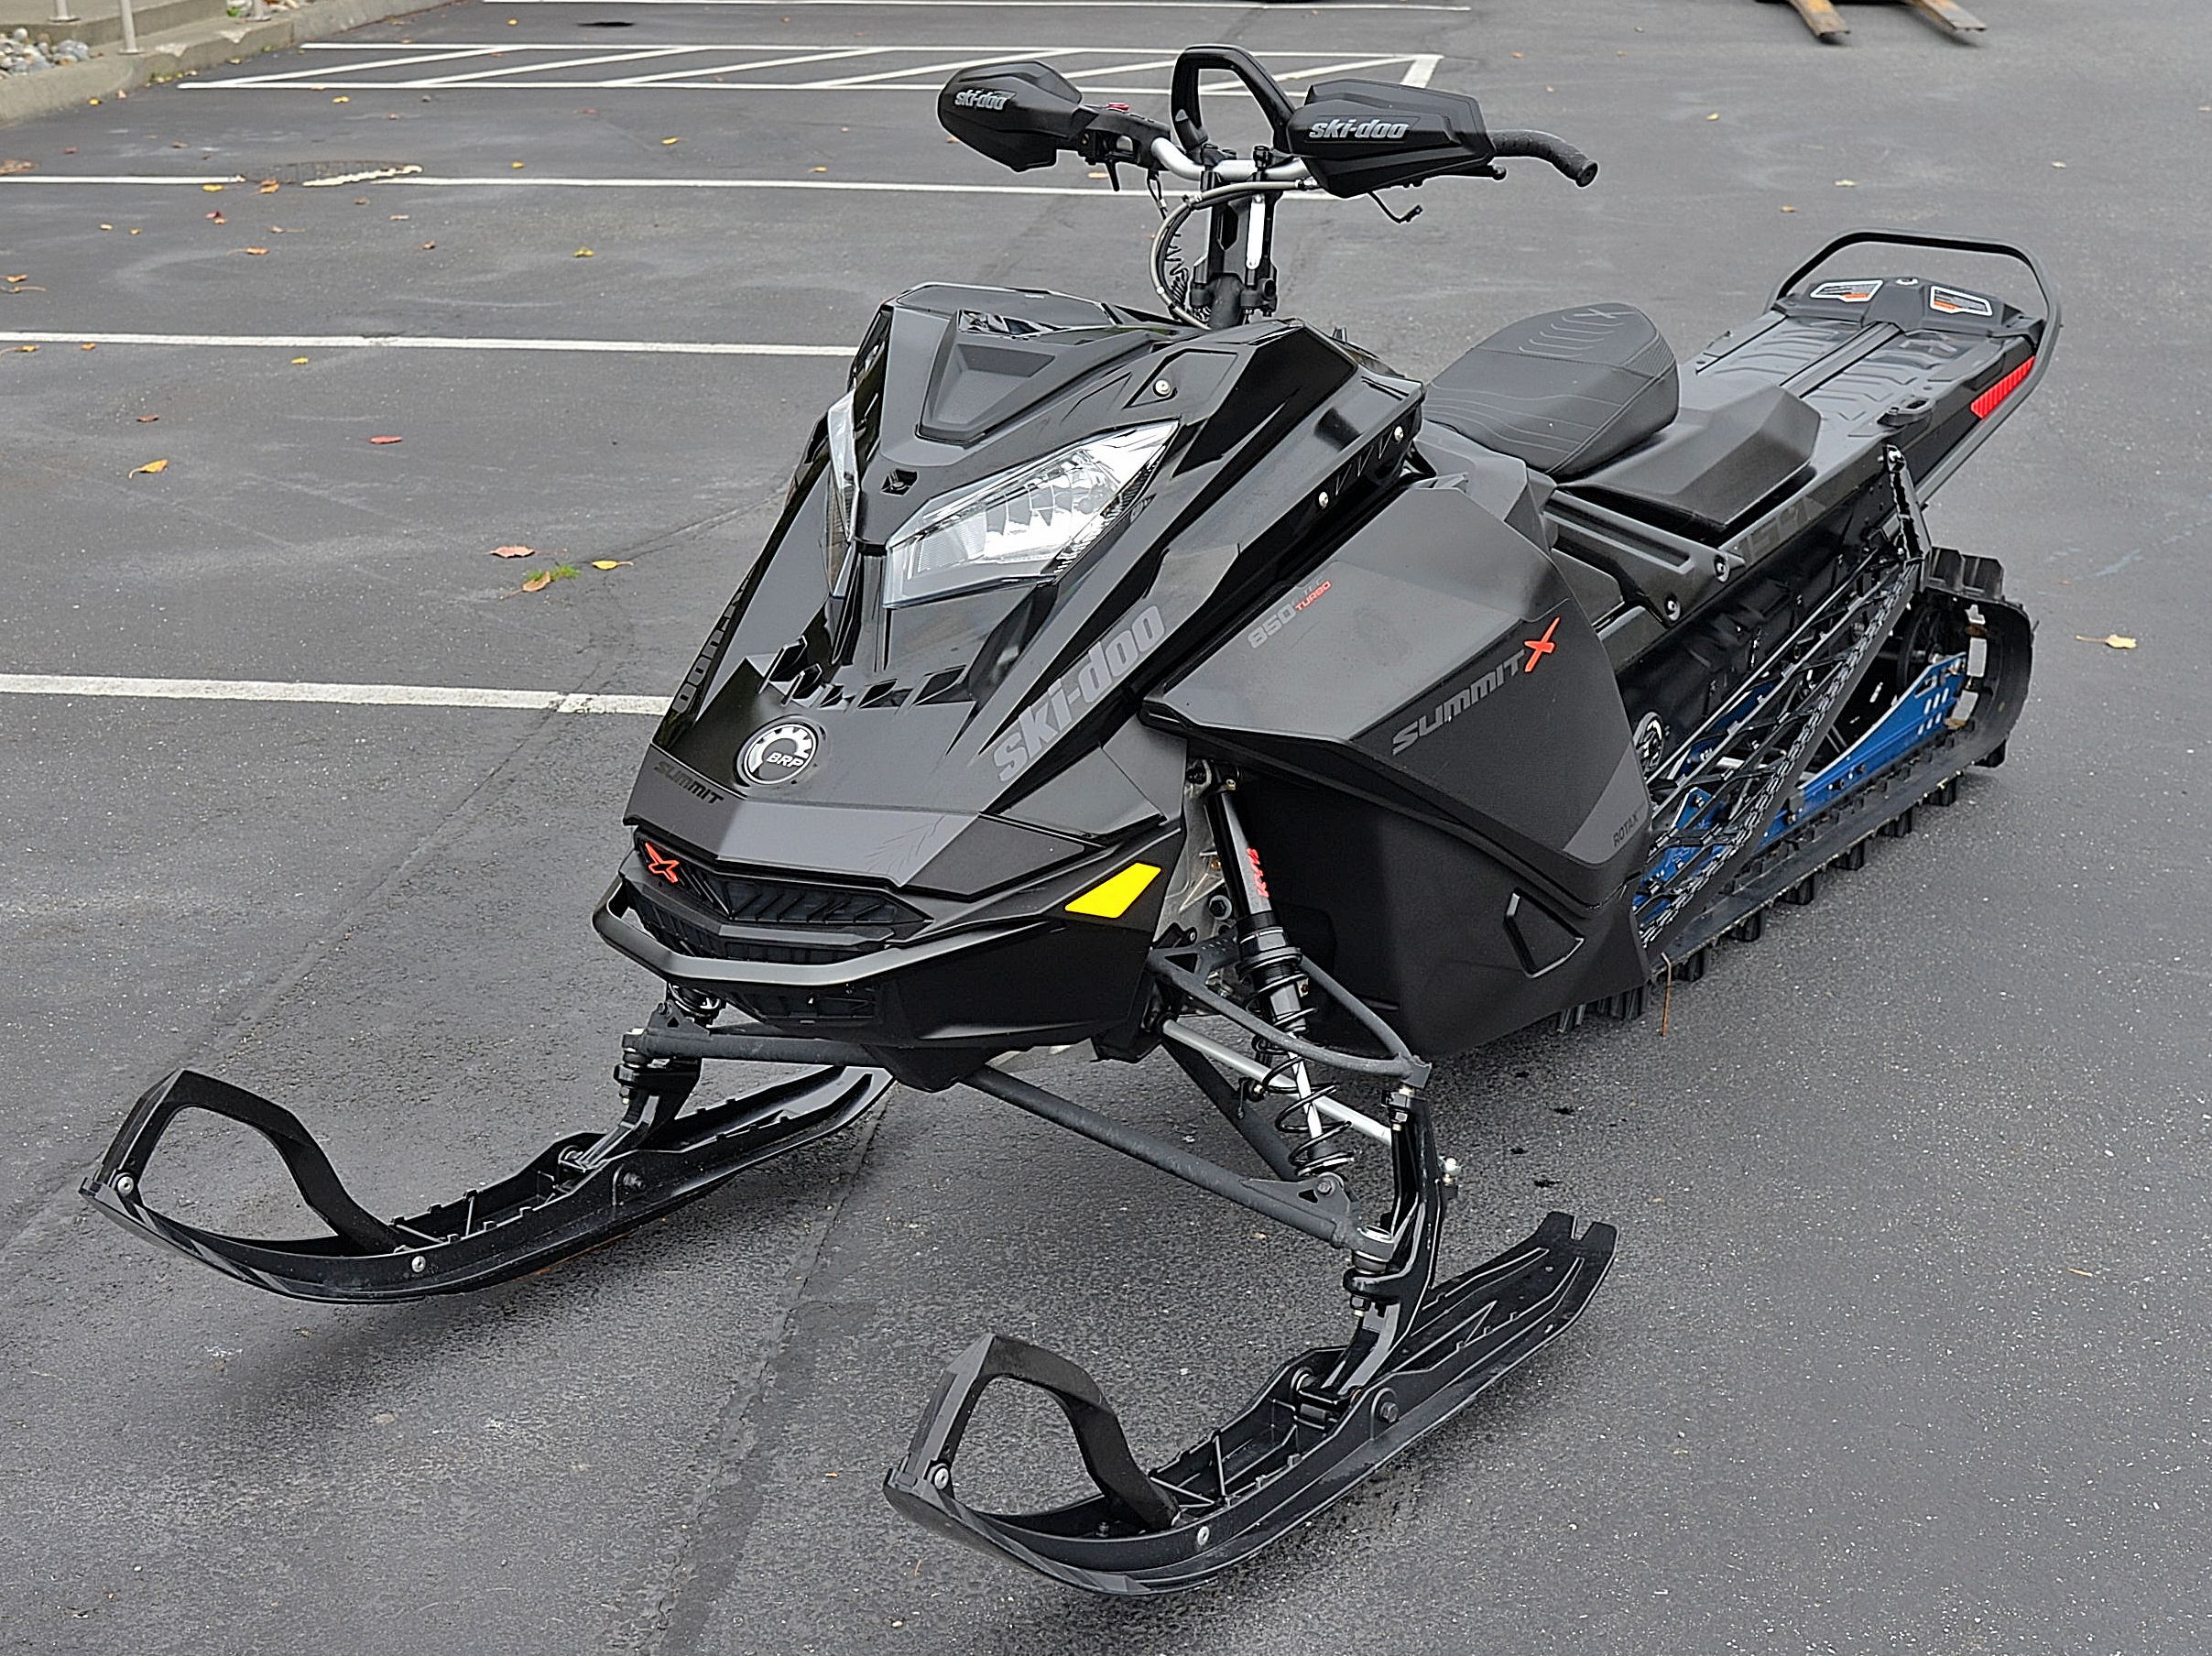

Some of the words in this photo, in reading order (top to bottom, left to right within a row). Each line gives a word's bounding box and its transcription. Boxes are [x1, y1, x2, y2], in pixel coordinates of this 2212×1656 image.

[954, 89, 1008, 110] ski-doo
[1309, 119, 1409, 138] ski-doo
[1295, 581, 1332, 611] TURBO
[1248, 604, 1297, 648] 850
[994, 605, 1166, 782] ski-doo
[1392, 648, 1525, 756] SUMMIT
[1523, 616, 1561, 672] X
[766, 752, 805, 768] BRP
[653, 761, 725, 805] SUMMIT
[1612, 810, 1640, 847] ROTAX
